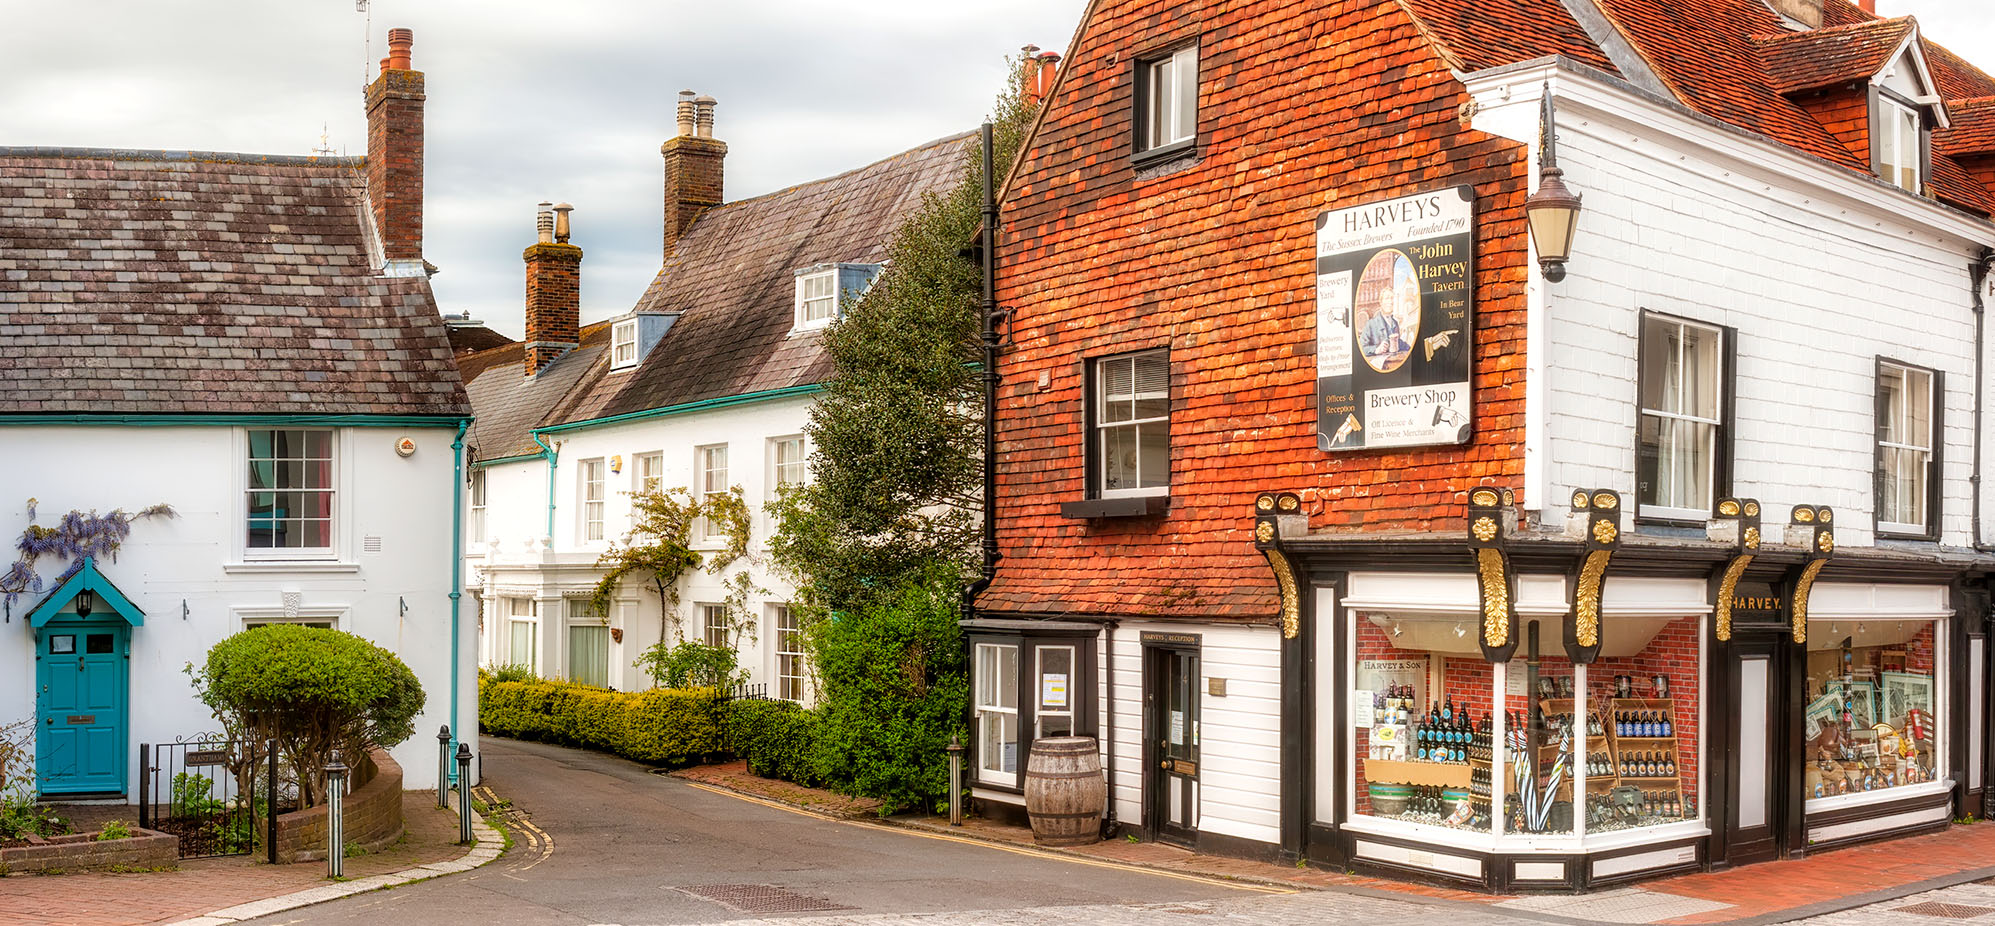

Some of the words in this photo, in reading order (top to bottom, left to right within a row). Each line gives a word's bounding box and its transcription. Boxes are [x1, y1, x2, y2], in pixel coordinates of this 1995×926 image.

[1344, 196, 1440, 233] HARVEYS
[1321, 241, 1338, 252] The
[1337, 238, 1362, 249] Sussex
[1363, 232, 1393, 245] Brewers
[1407, 220, 1443, 237] Founded
[1444, 217, 1466, 231] 1790
[1409, 246, 1420, 254] The
[1419, 242, 1453, 260] John
[1419, 261, 1468, 279] Harvey
[1319, 276, 1349, 288] Brewery
[1432, 280, 1465, 293] Tavern
[1440, 301, 1448, 309] In
[1448, 310, 1465, 319] Yard
[1326, 394, 1346, 403] Offices
[1348, 393, 1355, 401] &
[1371, 393, 1422, 408] Brewery
[1424, 389, 1456, 406] Shop
[1326, 404, 1356, 415] Reception
[1371, 431, 1385, 440] Fine
[1385, 430, 1401, 439] Wine
[1403, 428, 1435, 438] Merchants
[1143, 633, 1165, 641] HARVEYS
[1168, 634, 1195, 642] RECEPTION
[1364, 661, 1398, 670] HARVEY
[1405, 661, 1421, 669] SON
